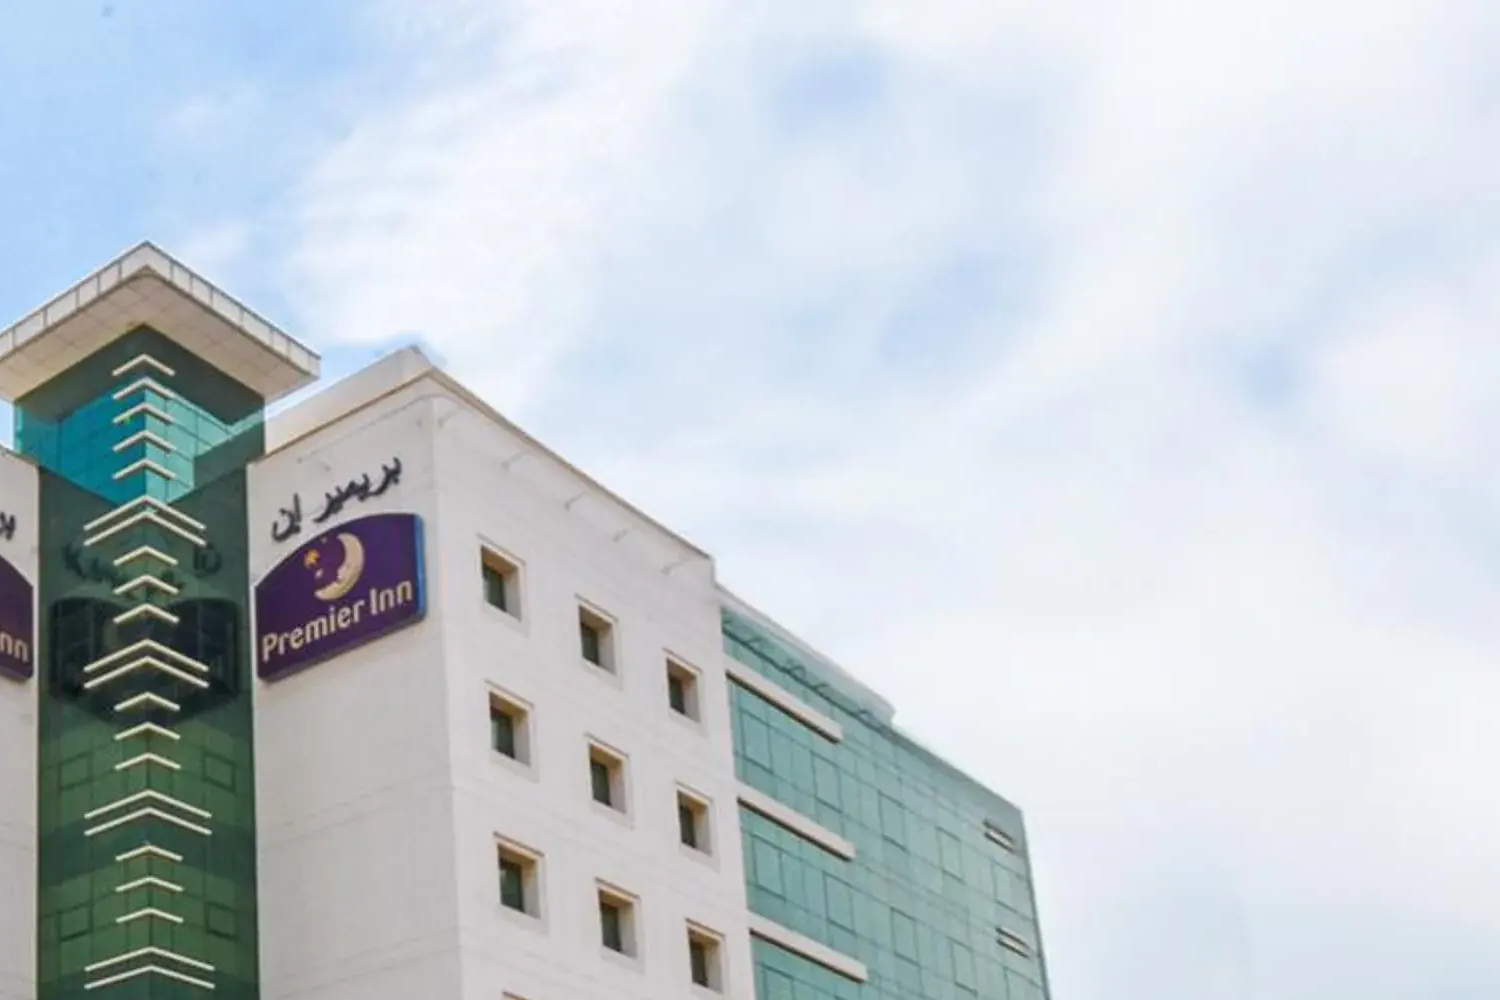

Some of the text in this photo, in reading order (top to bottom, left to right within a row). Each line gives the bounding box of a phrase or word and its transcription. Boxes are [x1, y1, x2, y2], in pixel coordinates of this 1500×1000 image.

[312, 456, 402, 523] بريمير
[261, 579, 414, 663] Premier Inn
